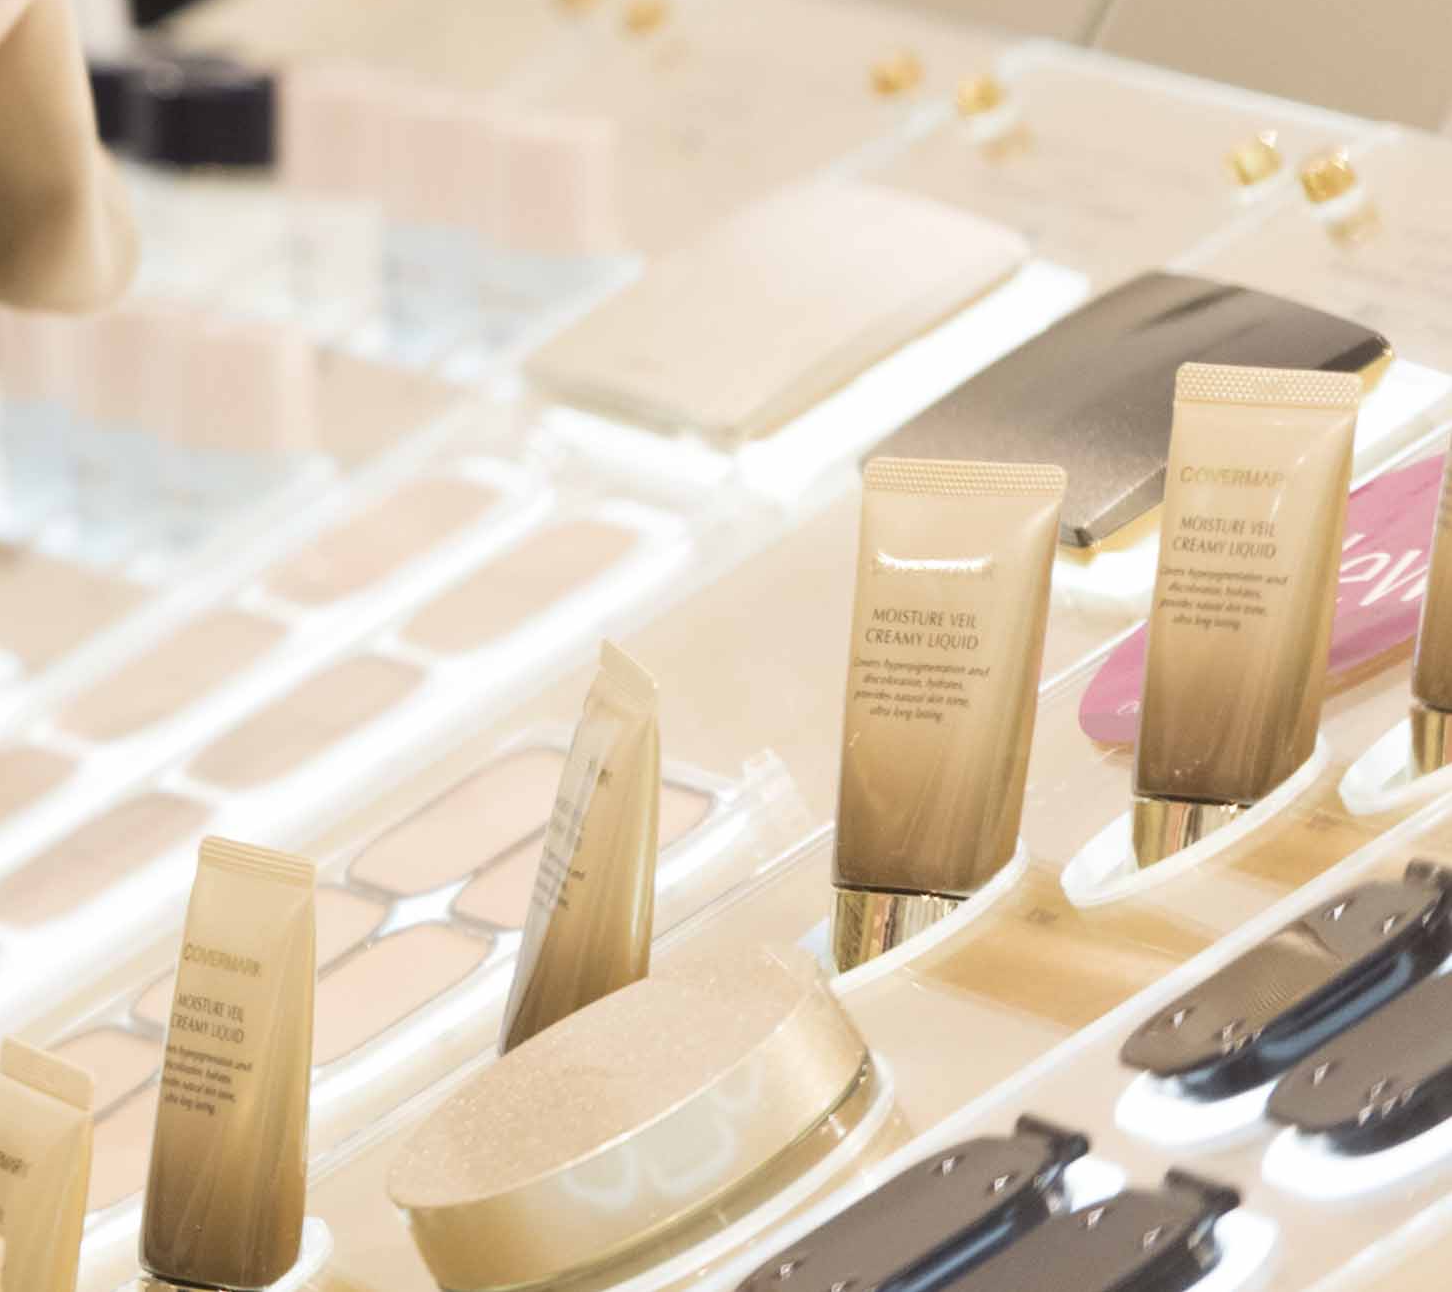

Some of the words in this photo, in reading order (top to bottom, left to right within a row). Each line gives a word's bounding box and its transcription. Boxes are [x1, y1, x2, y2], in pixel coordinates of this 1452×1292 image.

[1180, 466, 1287, 487] COVERMAR
[1180, 516, 1246, 536] MOISTURE
[1250, 520, 1277, 538] VEIL
[1173, 536, 1227, 555] CREAMY
[1229, 540, 1277, 559] LIQUID
[872, 608, 945, 628] MOISTURE
[949, 612, 977, 630] VEIL
[865, 628, 926, 647] CREAMY
[927, 632, 980, 651] LIQUID
[968, 666, 991, 677] and
